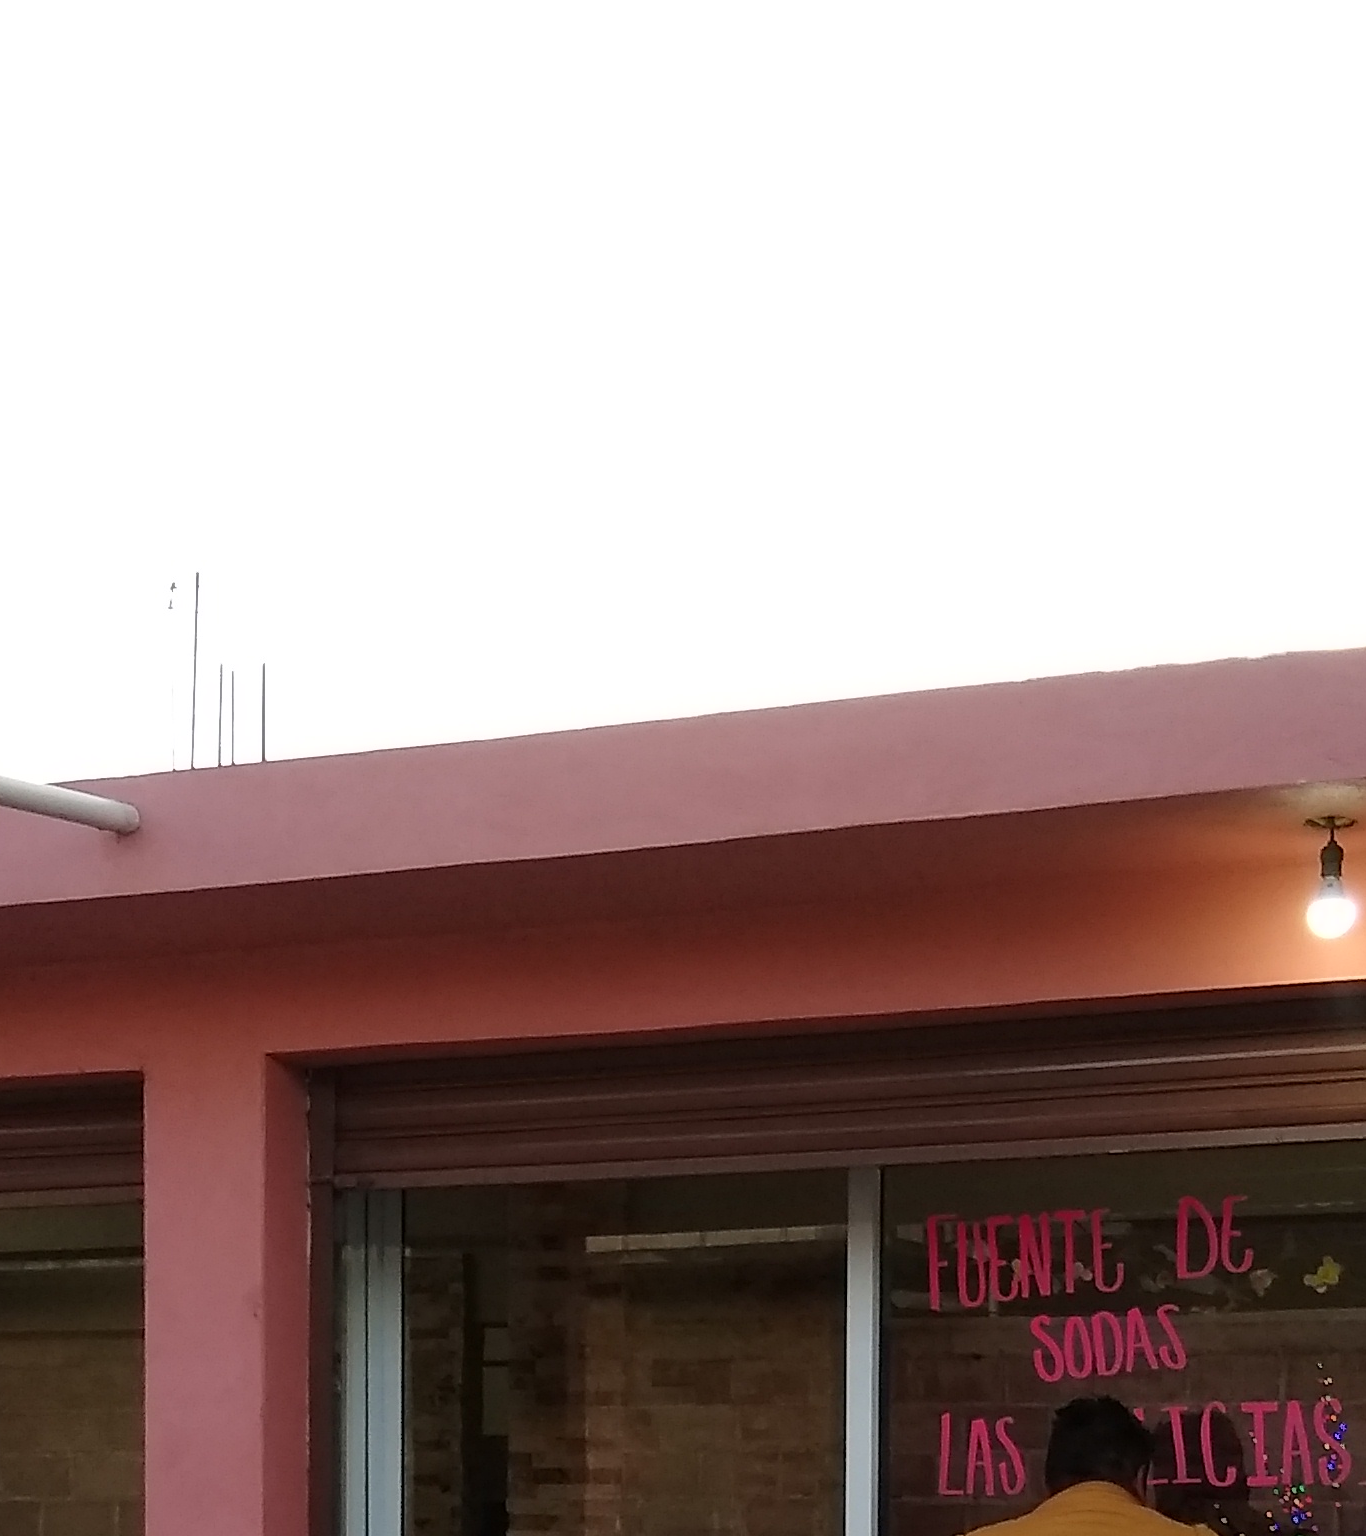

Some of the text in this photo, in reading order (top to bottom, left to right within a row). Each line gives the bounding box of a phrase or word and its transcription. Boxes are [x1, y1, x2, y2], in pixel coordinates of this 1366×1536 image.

[926, 1195, 1254, 1311] FUENTE DE
[1029, 1303, 1188, 1384] SODAS
[938, 1411, 1027, 1497] LAS
